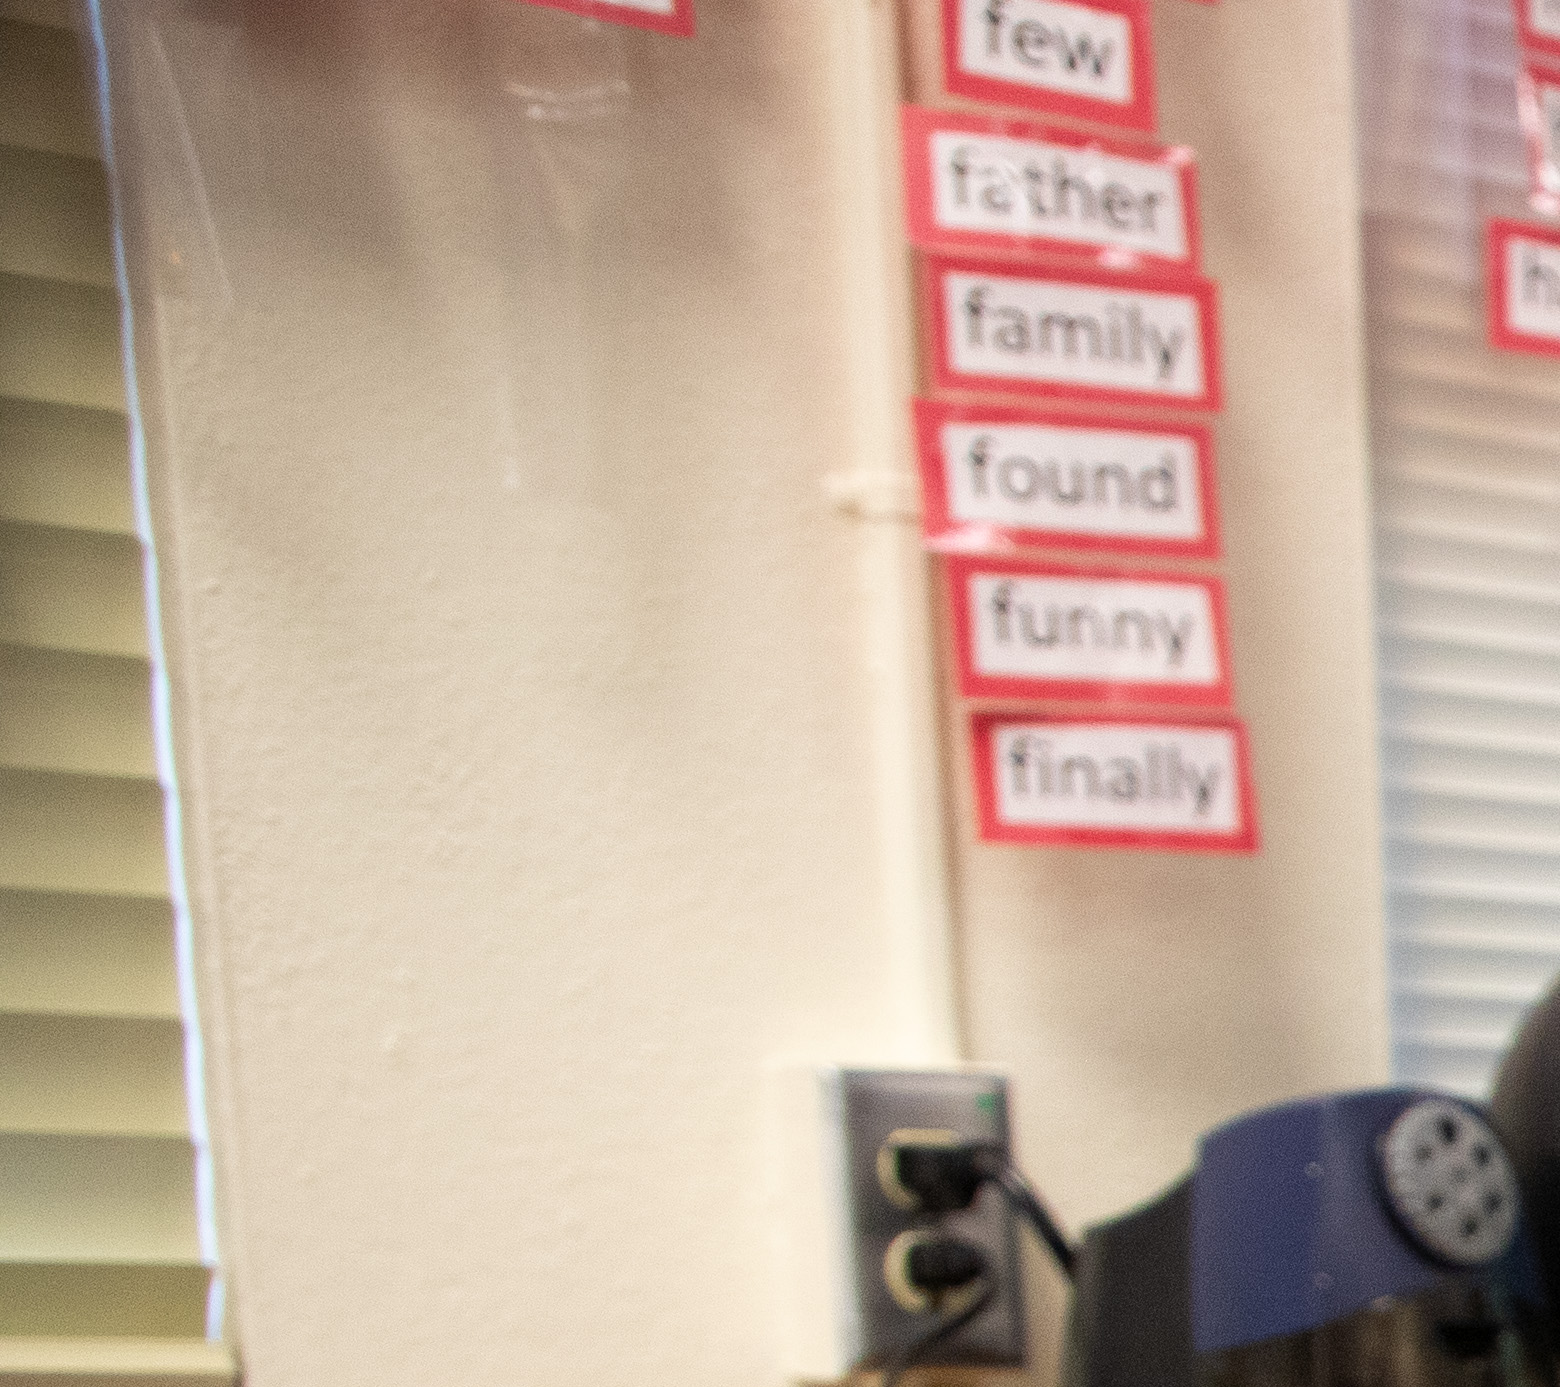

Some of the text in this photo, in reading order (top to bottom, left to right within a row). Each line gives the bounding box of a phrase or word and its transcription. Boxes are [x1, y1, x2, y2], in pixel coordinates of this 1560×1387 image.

[981, 2, 1115, 81] few
[950, 147, 1166, 233] father
[962, 285, 1188, 378] family
[966, 437, 1180, 515] found
[988, 584, 1196, 662] funny
[1006, 731, 1223, 814] finally
